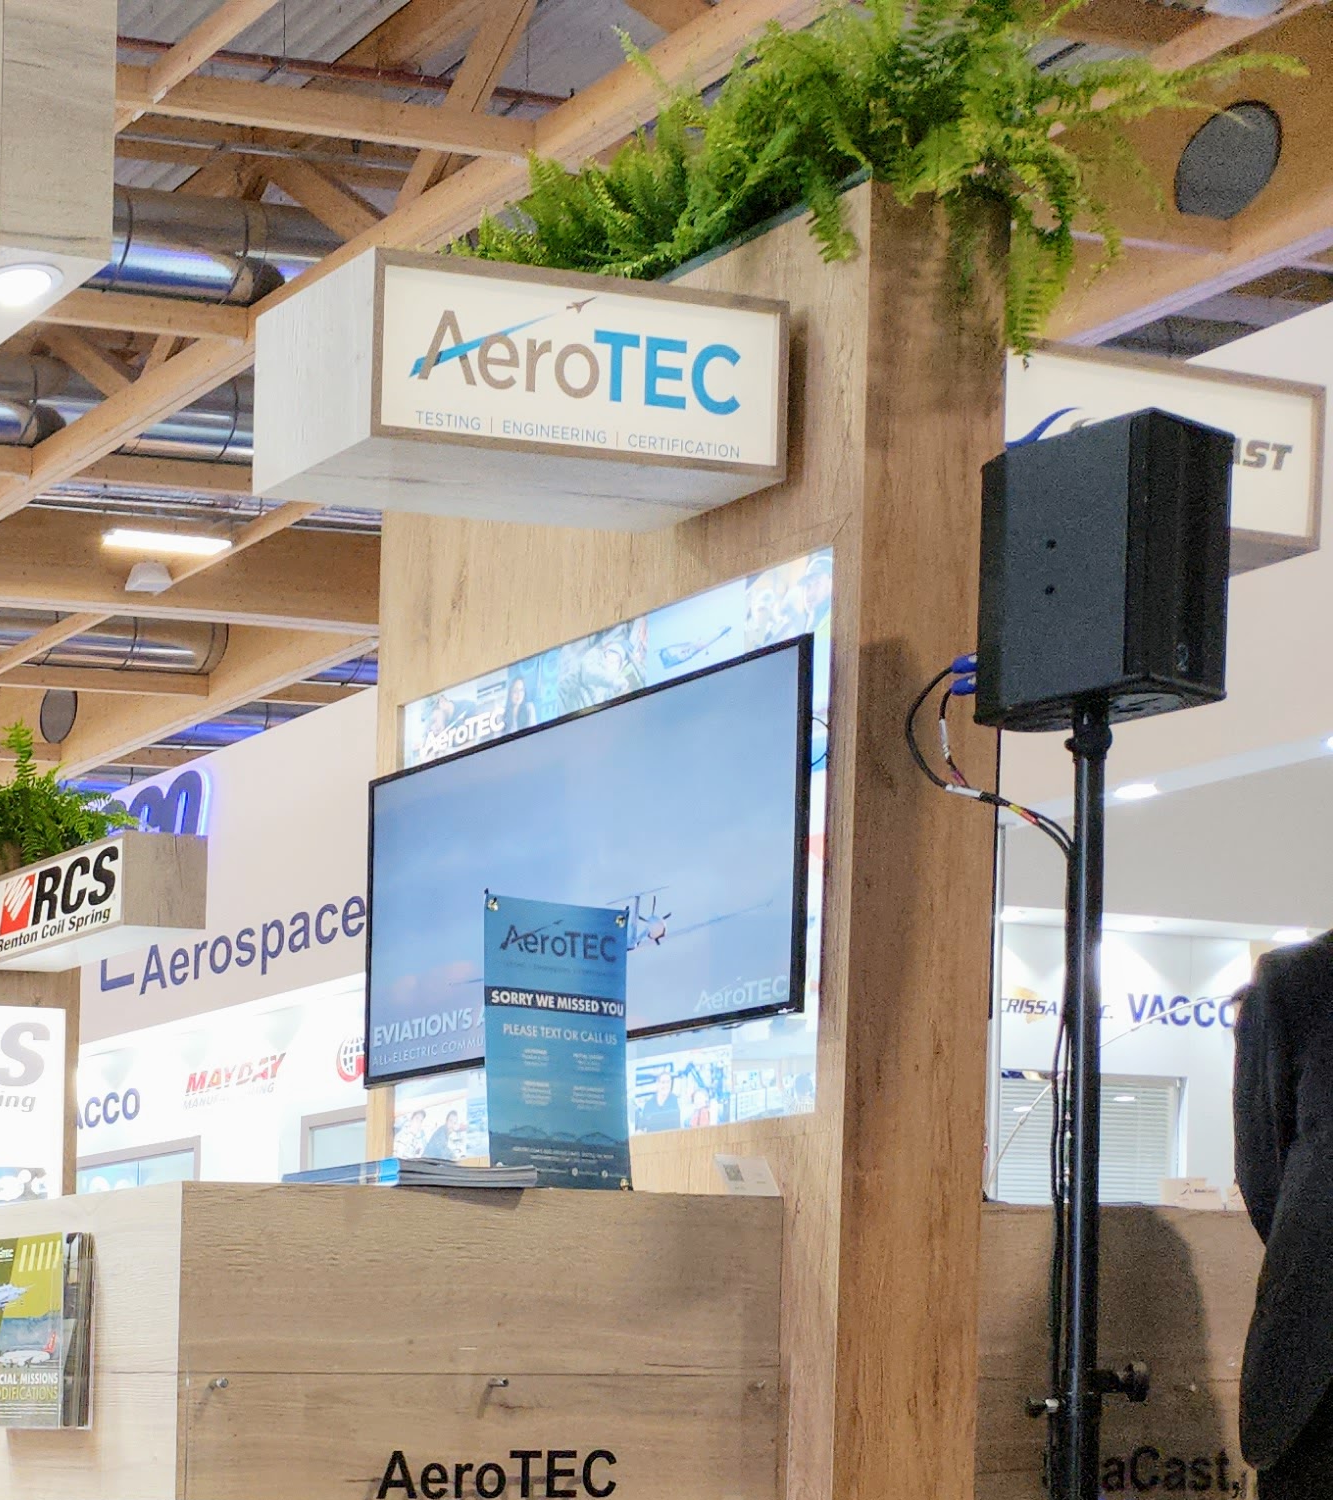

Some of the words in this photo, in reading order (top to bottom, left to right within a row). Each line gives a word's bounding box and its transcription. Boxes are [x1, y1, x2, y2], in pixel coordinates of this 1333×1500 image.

[413, 309, 742, 416] AeroTEC
[416, 410, 482, 431] TESTING
[502, 420, 608, 445] ENGINEERING
[628, 433, 741, 460] CERTIFICATION
[31, 846, 119, 926] RCS
[41, 920, 65, 940] Coil
[68, 908, 111, 932] Spring
[500, 924, 617, 963] AeroTEC
[139, 895, 366, 996] Aerospace
[491, 990, 534, 1006] SORRY
[536, 993, 555, 1009] WE
[557, 996, 600, 1013] MISSED
[602, 1001, 624, 1016] YOU
[694, 976, 788, 1013] AeroTEC
[373, 1007, 473, 1048] EVIATION'S
[503, 1023, 538, 1038] PLEASE
[541, 1026, 562, 1039] TEXT
[564, 1029, 579, 1041] OR
[580, 1030, 602, 1043] CALL
[606, 1034, 618, 1046] US
[185, 1052, 287, 1094] MAYDAY
[20, 1372, 58, 1386] MISSIONS
[376, 1449, 618, 1500] AeroTEC
